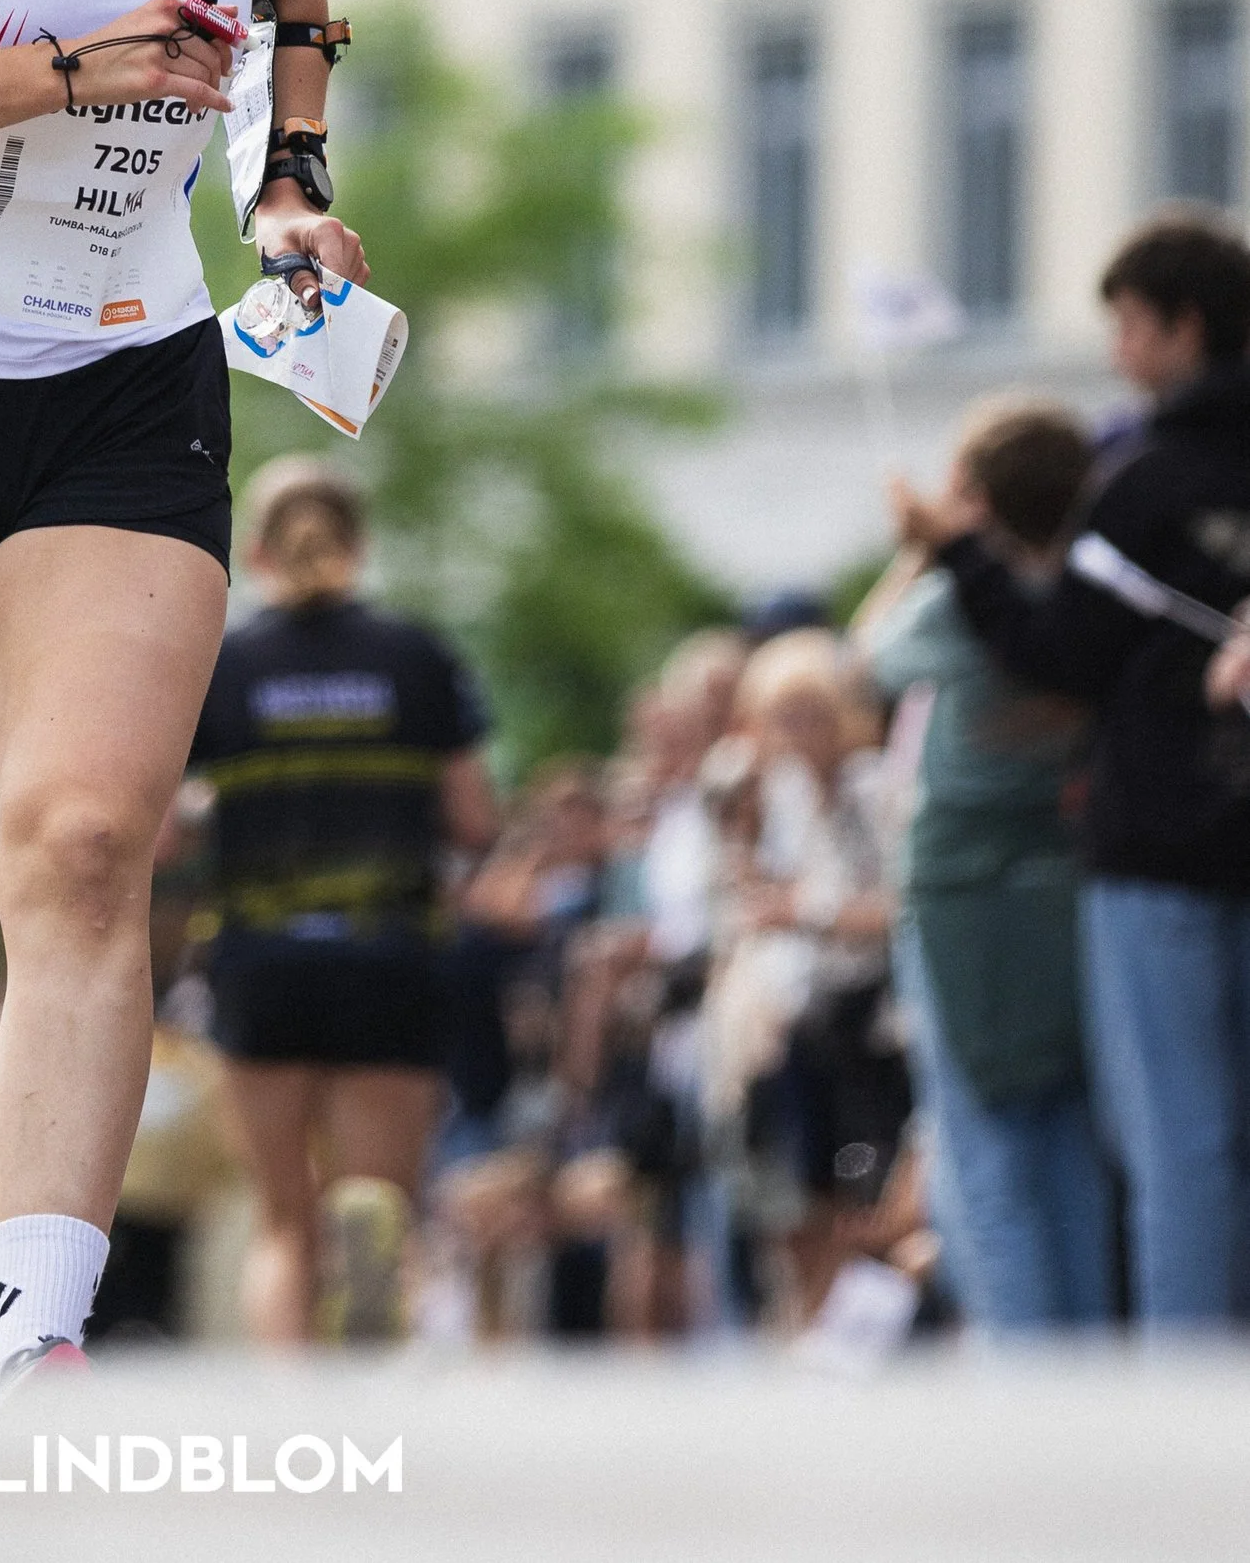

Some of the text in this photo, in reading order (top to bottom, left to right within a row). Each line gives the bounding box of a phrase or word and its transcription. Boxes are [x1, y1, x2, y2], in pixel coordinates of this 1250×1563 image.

[93, 143, 163, 176] 7205
[73, 186, 146, 217] HILMA
[89, 243, 109, 256] D18
[22, 294, 93, 319] CHALMERS
